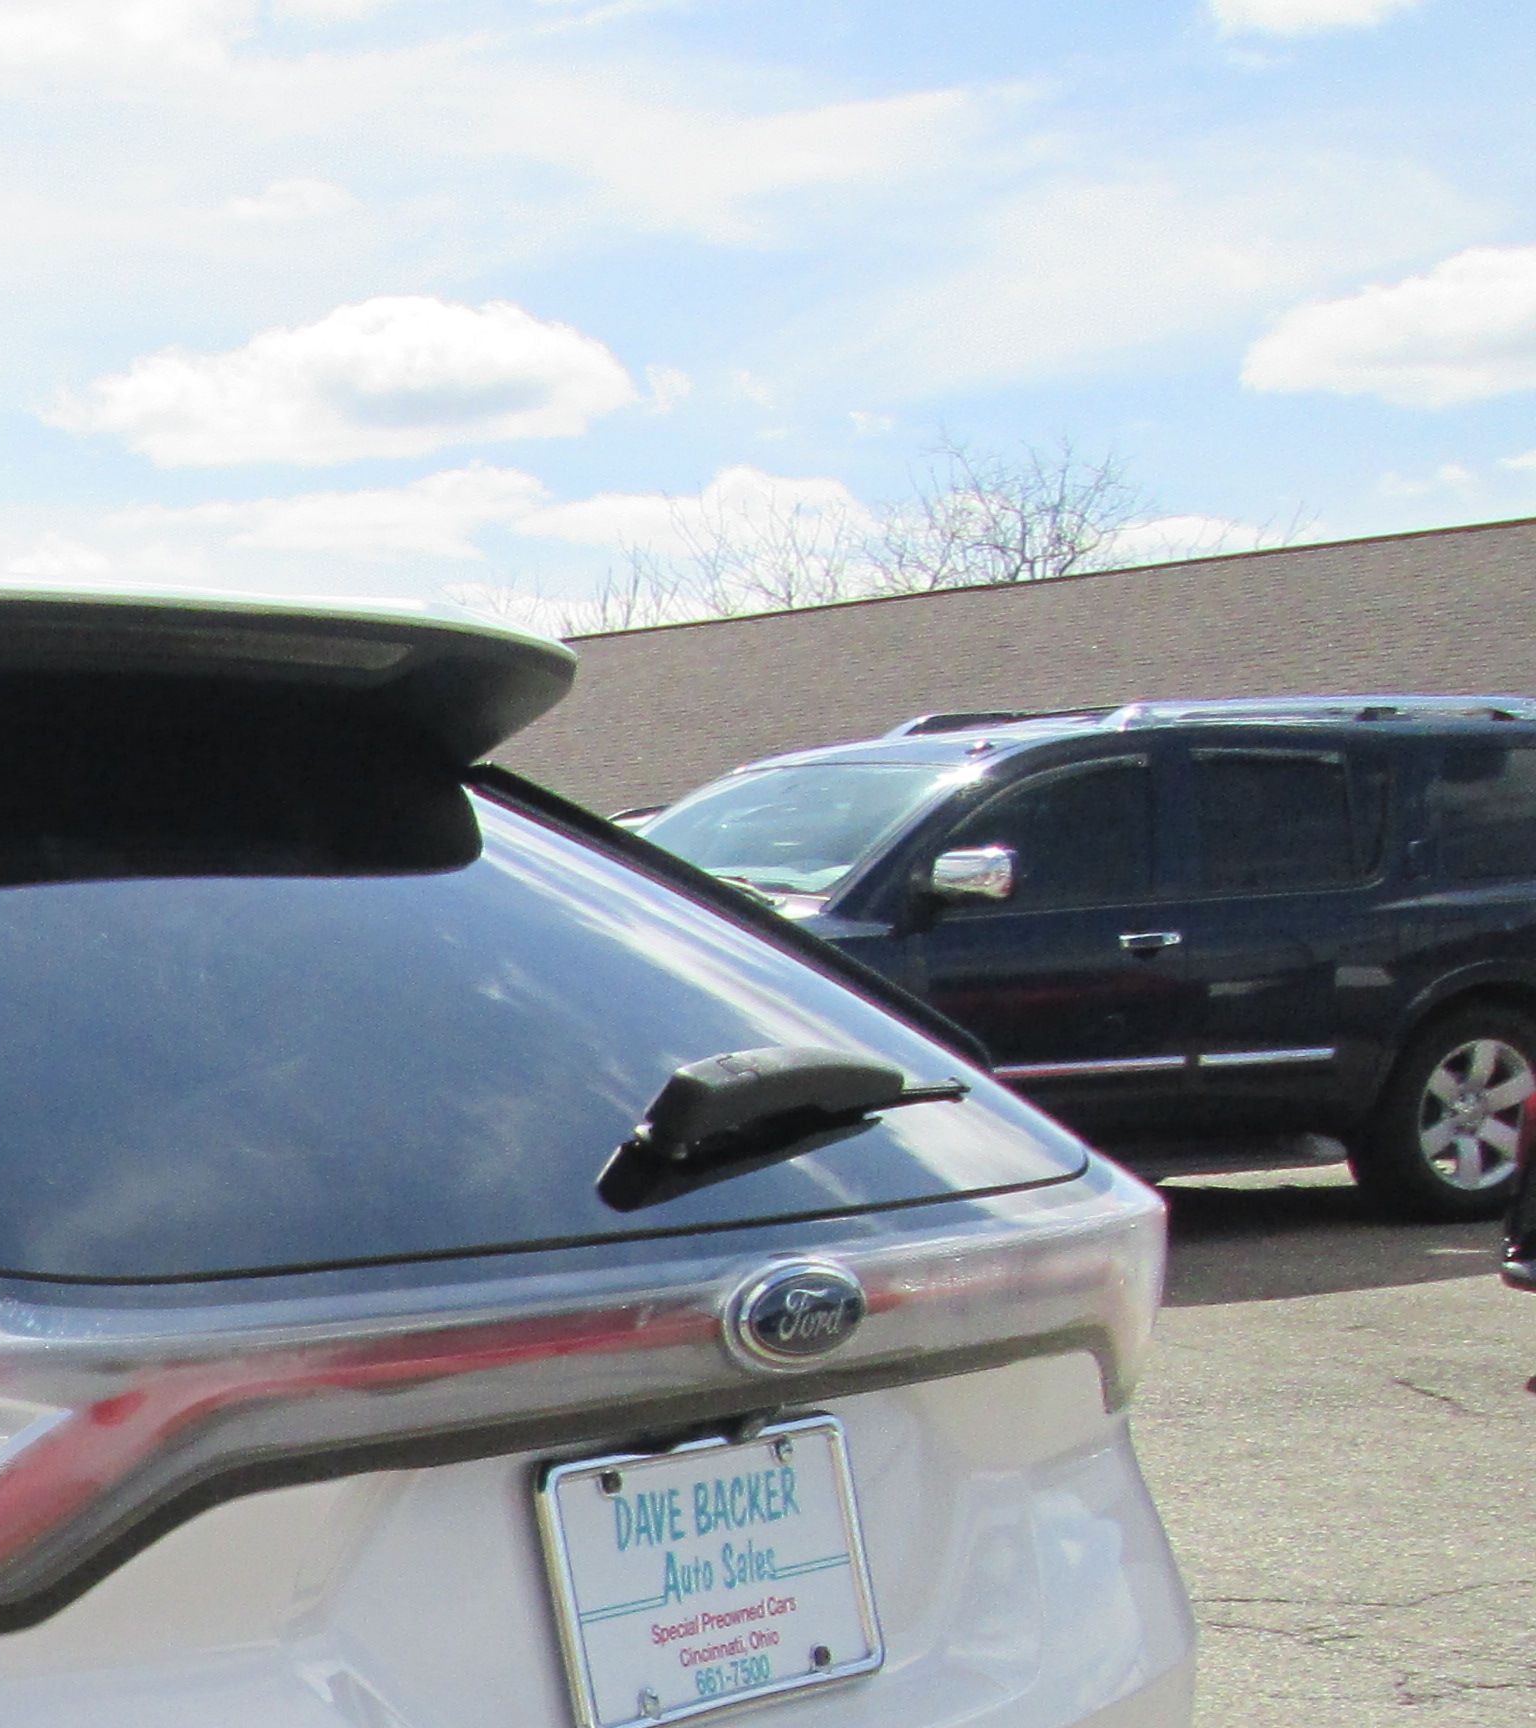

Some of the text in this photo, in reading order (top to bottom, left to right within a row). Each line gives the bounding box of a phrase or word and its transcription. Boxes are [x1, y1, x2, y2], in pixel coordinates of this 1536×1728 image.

[779, 1287, 846, 1341] Ford
[614, 1465, 801, 1552] DAVE BACKER
[664, 1540, 778, 1605] Auto Sales
[651, 1596, 798, 1647] Special Preowned Cars
[679, 1628, 780, 1668] Cincinnati, Ohio
[695, 1653, 771, 1696] 661-7500
